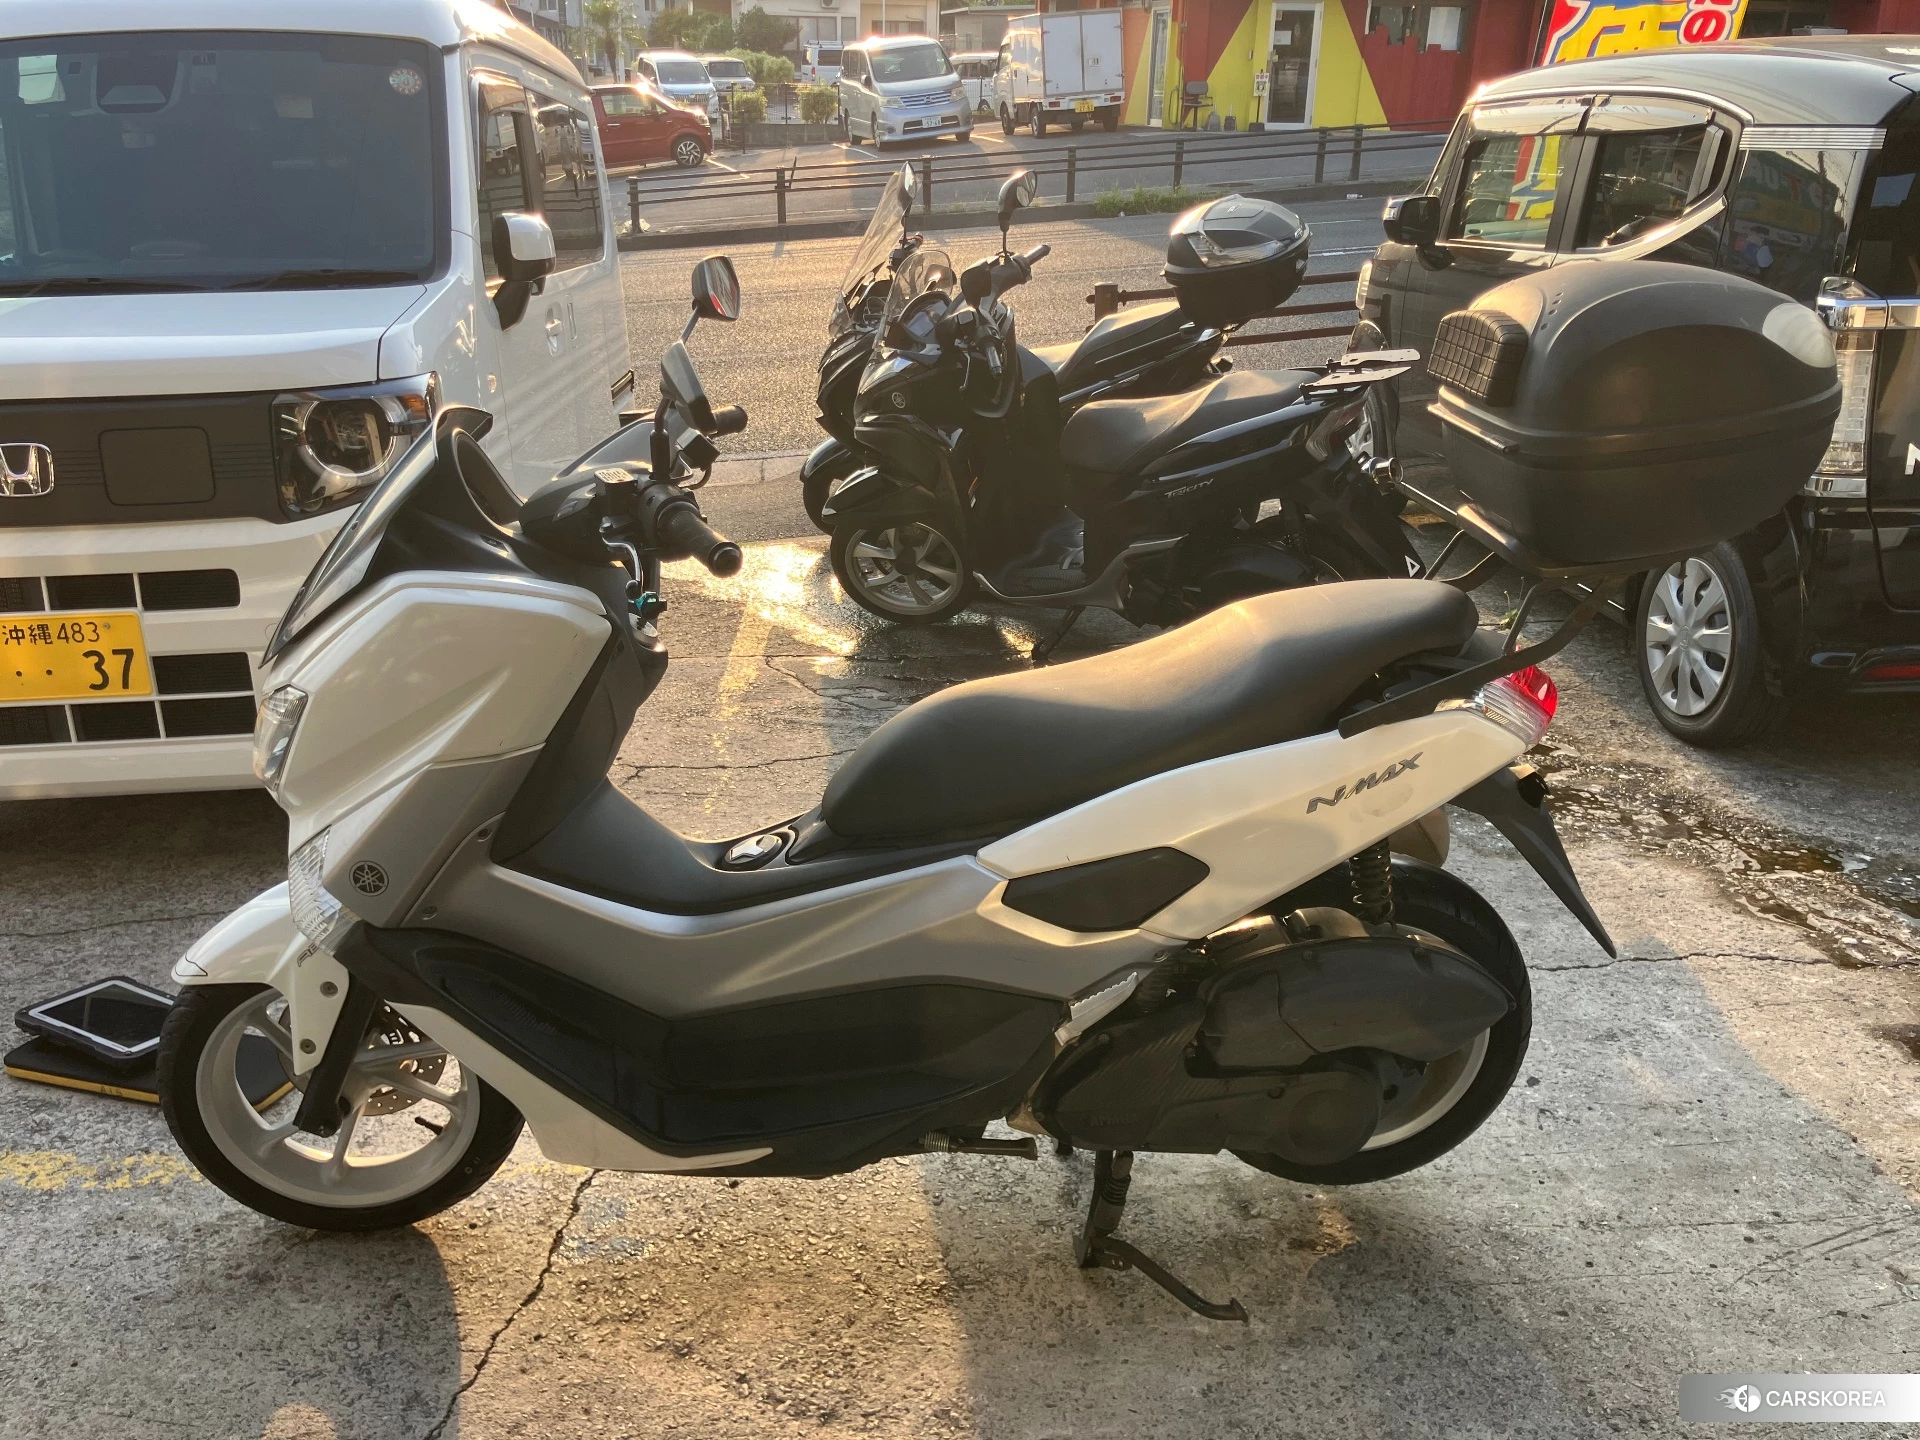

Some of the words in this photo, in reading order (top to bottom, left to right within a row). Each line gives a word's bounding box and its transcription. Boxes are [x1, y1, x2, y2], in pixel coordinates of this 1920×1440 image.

[1164, 478, 1214, 499] TRICITY
[2, 624, 53, 646] 沖縄
[57, 621, 100, 644] 483
